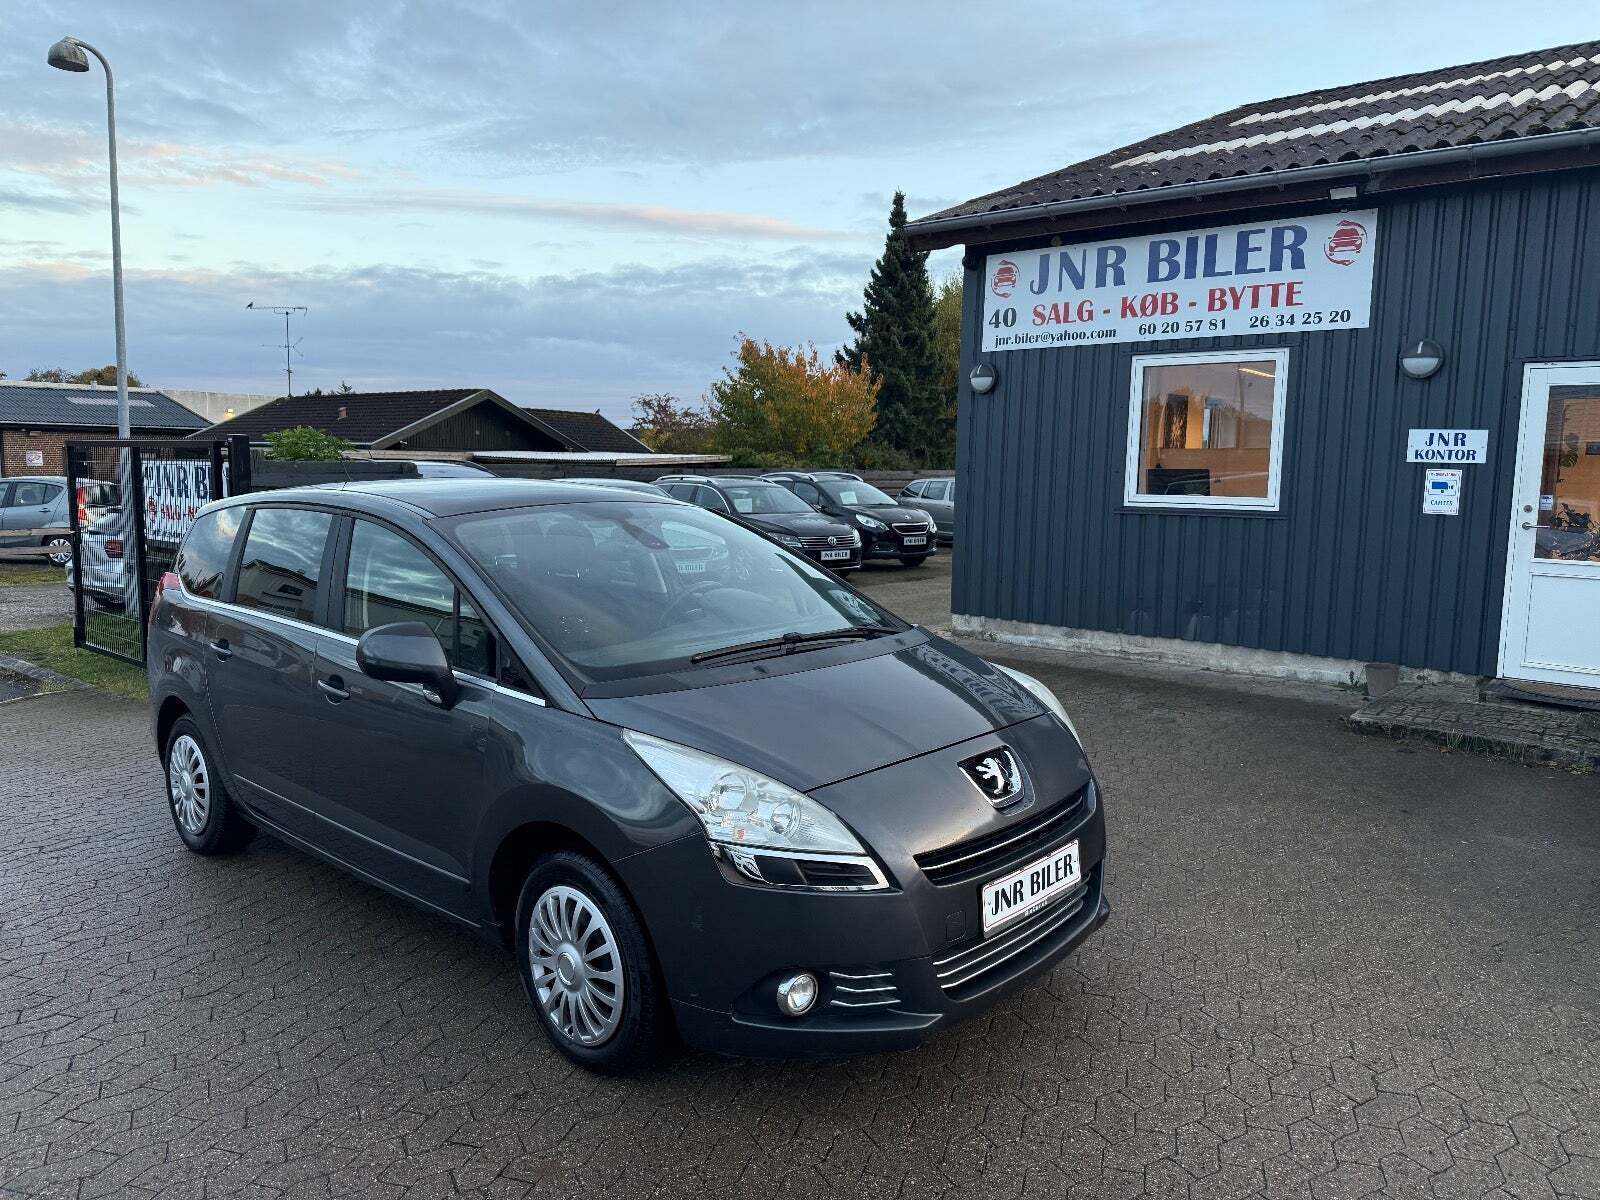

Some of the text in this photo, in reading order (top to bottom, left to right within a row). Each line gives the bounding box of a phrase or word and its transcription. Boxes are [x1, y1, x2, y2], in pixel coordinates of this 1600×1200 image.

[1029, 224, 1309, 296] JNR BILER
[1032, 299, 1094, 327] SALG
[1120, 291, 1179, 319] KØB
[1207, 281, 1304, 312] BYTTE
[988, 307, 1017, 329] 40
[1138, 309, 1351, 336] 60 20 57 81 26 34 25 20
[994, 328, 1117, 348] jnr.biler@yahoo.com
[1424, 432, 1467, 447] JNR
[1414, 449, 1477, 461] KONTOR
[991, 879, 1025, 916] JNR
[1030, 853, 1074, 897] BILER
